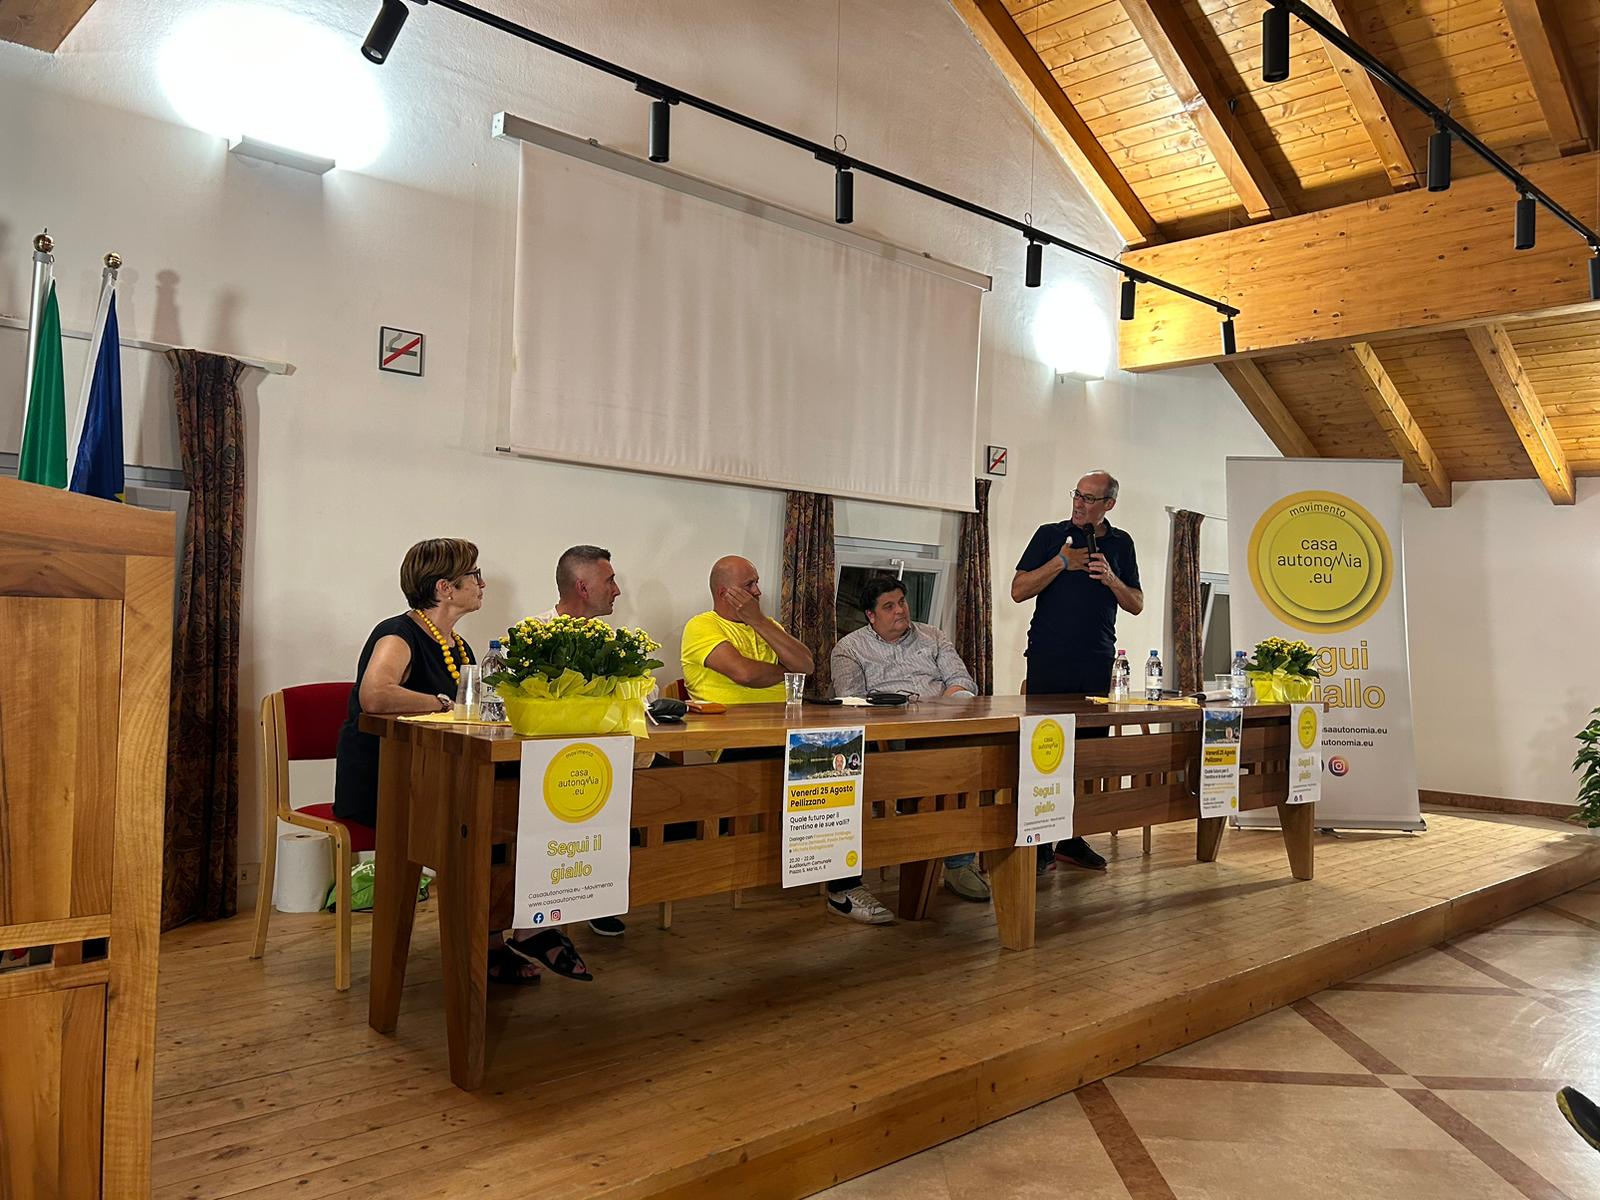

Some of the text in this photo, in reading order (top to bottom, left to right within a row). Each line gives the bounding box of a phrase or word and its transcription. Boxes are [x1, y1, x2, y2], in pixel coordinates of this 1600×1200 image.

[1289, 502, 1346, 518] movimento
[1301, 539, 1338, 550] casa
[1309, 572, 1332, 584] .eu
[1316, 640, 1369, 677] gui
[1310, 678, 1386, 709] iallo
[565, 749, 594, 759] movimento
[570, 769, 589, 778] casa
[820, 786, 829, 795] 25
[830, 785, 854, 796] Agosto
[1033, 783, 1054, 798] Segui
[790, 798, 826, 808] Pellizzano
[789, 815, 807, 824] Quale
[826, 812, 836, 821] per
[790, 823, 813, 832] Trentino
[547, 834, 602, 858] Segui il
[550, 861, 593, 885] giallo
